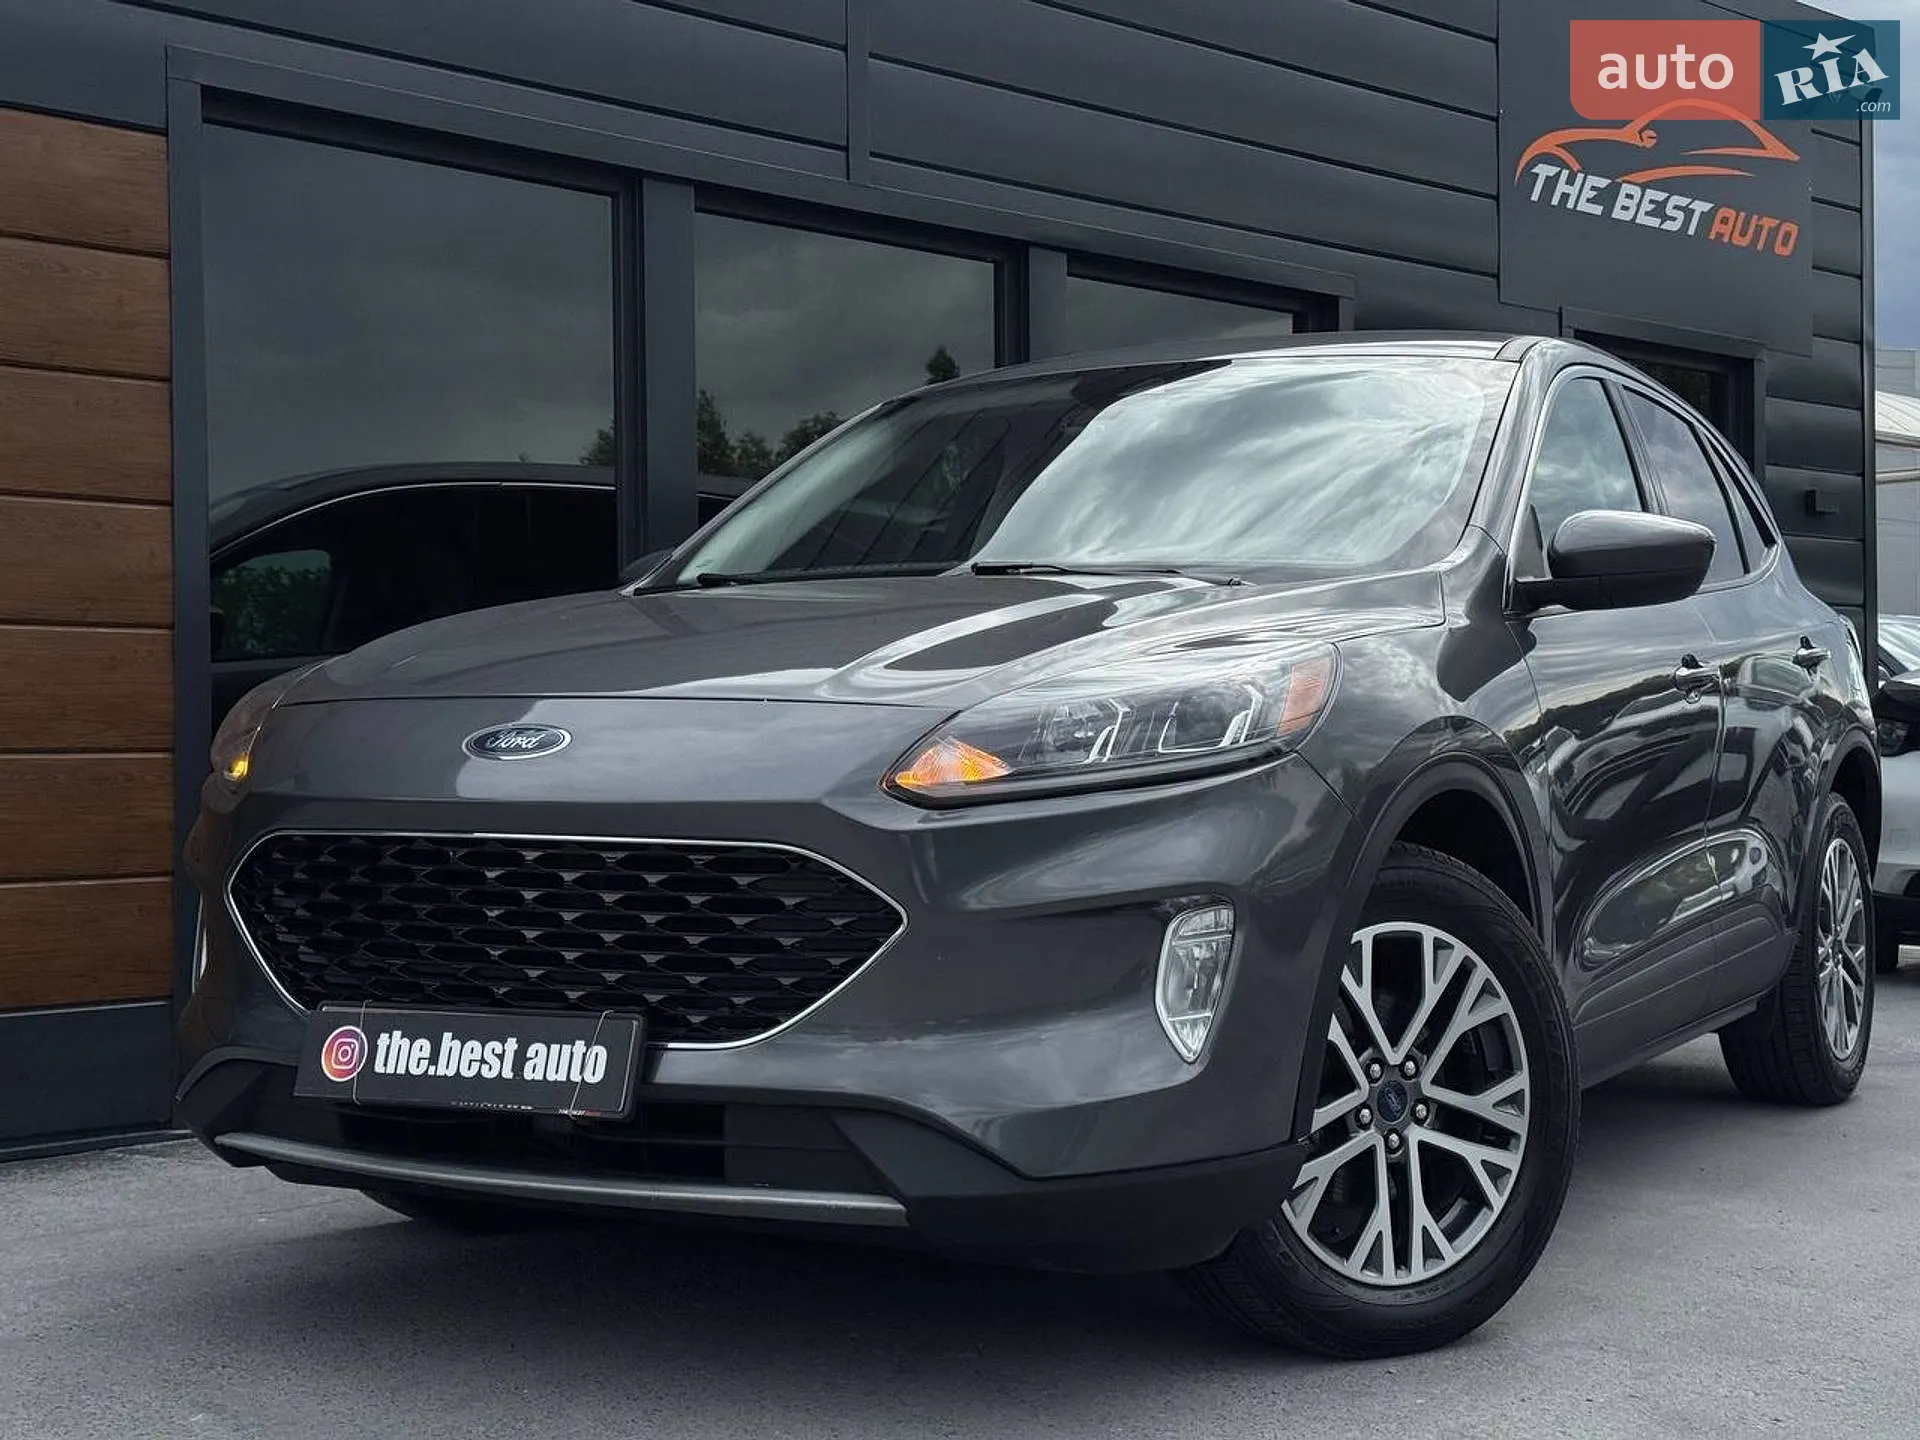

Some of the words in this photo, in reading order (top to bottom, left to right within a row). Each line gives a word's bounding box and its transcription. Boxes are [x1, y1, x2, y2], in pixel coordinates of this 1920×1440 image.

[1530, 163, 1612, 217] THE
[1611, 181, 1715, 237] BEST
[1708, 207, 1799, 258] AUTO
[486, 729, 547, 749] Ford
[374, 1030, 519, 1080] the.best
[523, 1040, 608, 1084] auto
